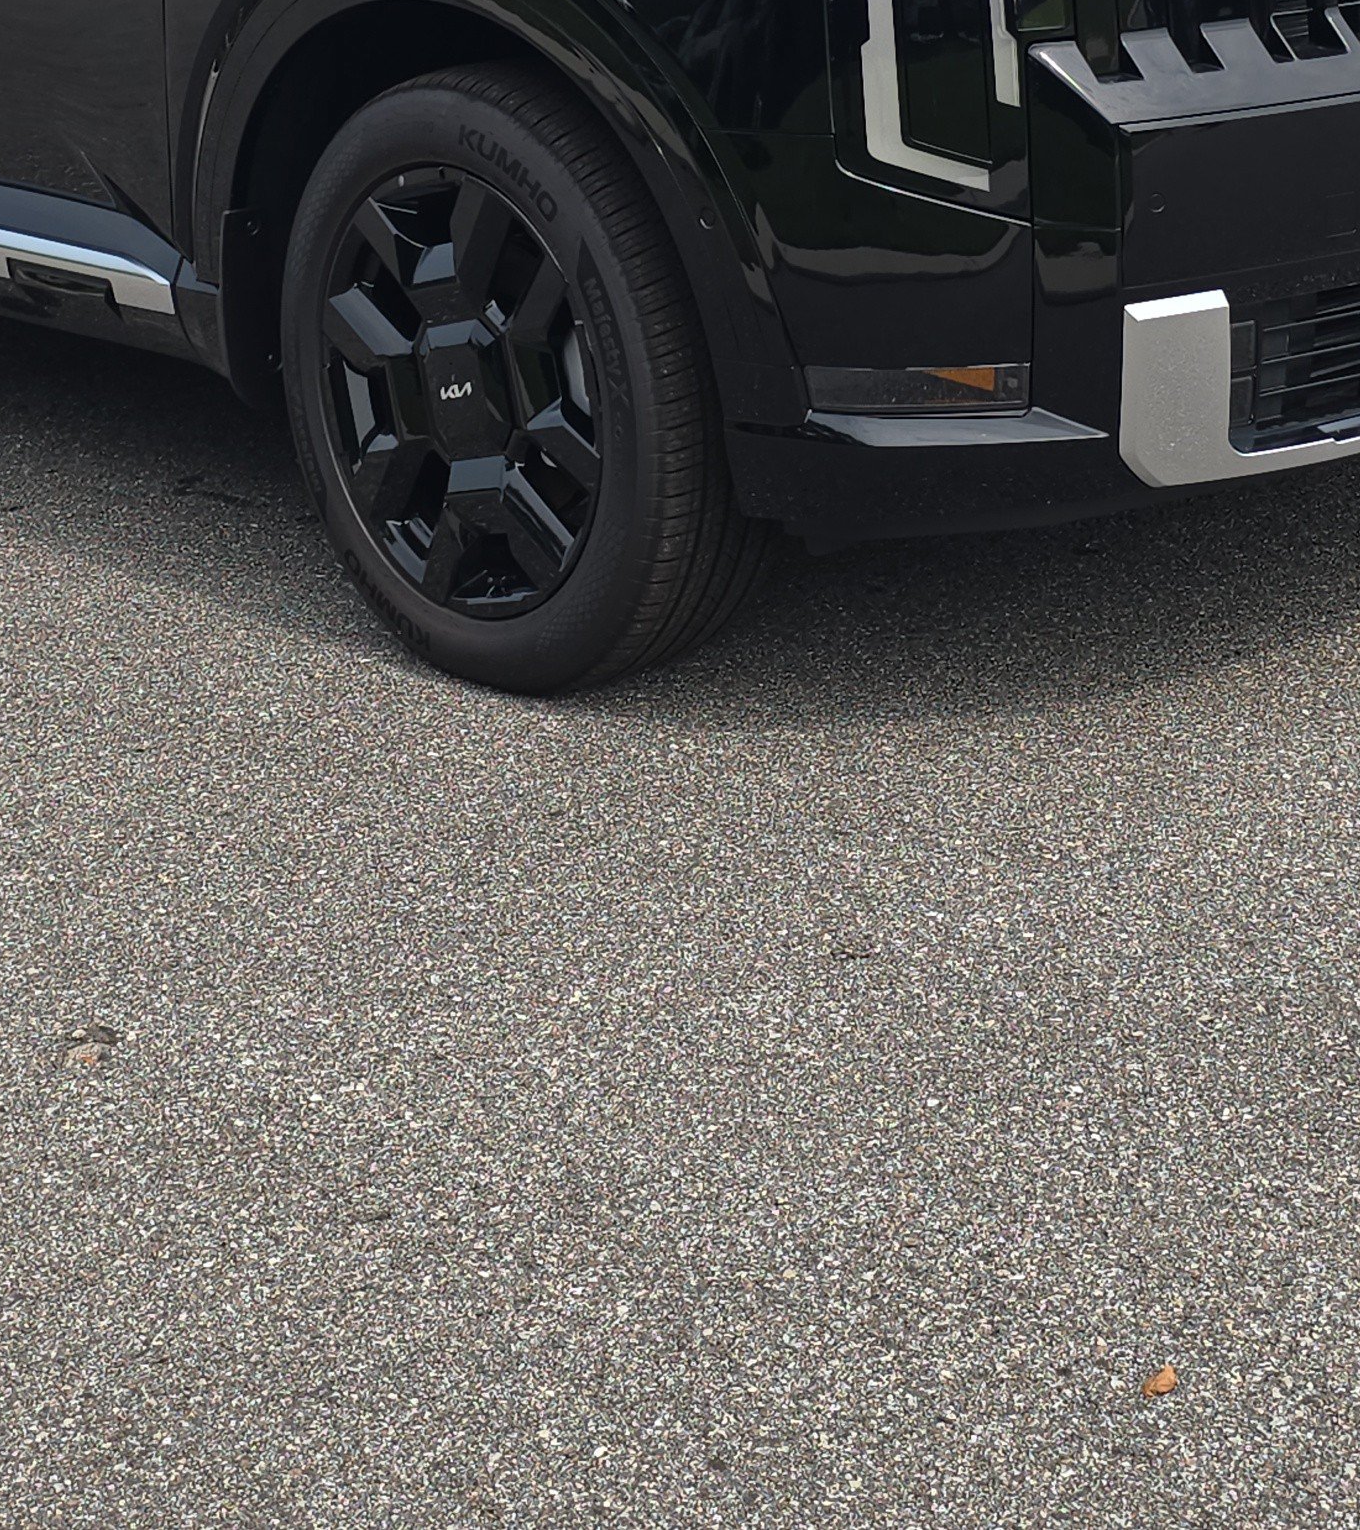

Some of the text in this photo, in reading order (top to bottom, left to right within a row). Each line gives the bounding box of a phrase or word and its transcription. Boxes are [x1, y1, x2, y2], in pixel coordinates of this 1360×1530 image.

[458, 124, 558, 223] KUMHO
[440, 381, 473, 400] KIA
[344, 548, 431, 652] KUMHO
